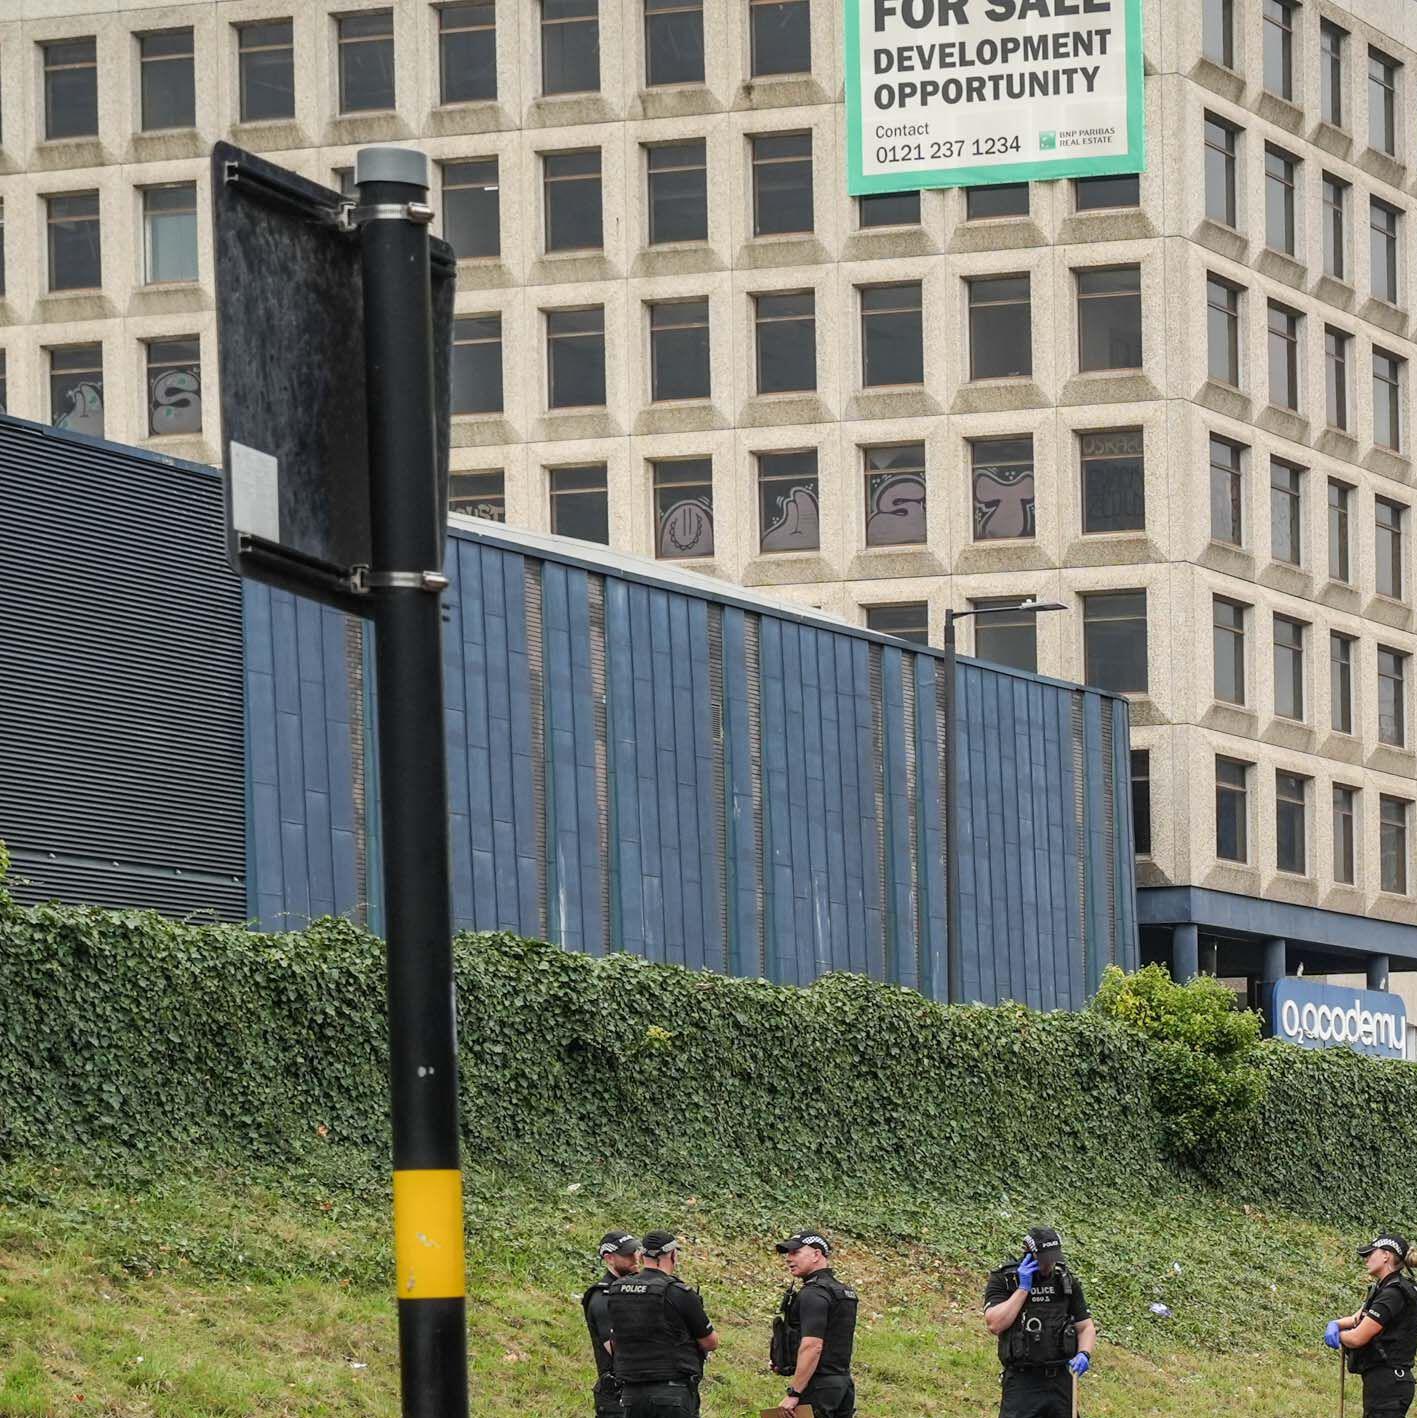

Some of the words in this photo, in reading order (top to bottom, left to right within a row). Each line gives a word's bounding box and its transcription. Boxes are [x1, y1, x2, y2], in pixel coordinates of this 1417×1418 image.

[874, 0, 969, 32] FOR
[984, 0, 1111, 22] SA
[874, 29, 1111, 74] DEVELOPMENT
[874, 66, 1100, 110] OPPORTUNITY
[876, 122, 929, 139] Contact
[1059, 130, 1077, 138] BNP
[1078, 127, 1115, 136] PARIBAS
[876, 143, 925, 163] 0121
[930, 140, 965, 159] 237
[972, 135, 1021, 156] 1234
[1059, 138, 1081, 147] REAL
[1082, 135, 1113, 145] ESTATE
[620, 1285, 647, 1293] POLICE
[1030, 1286, 1056, 1295] OLICE
